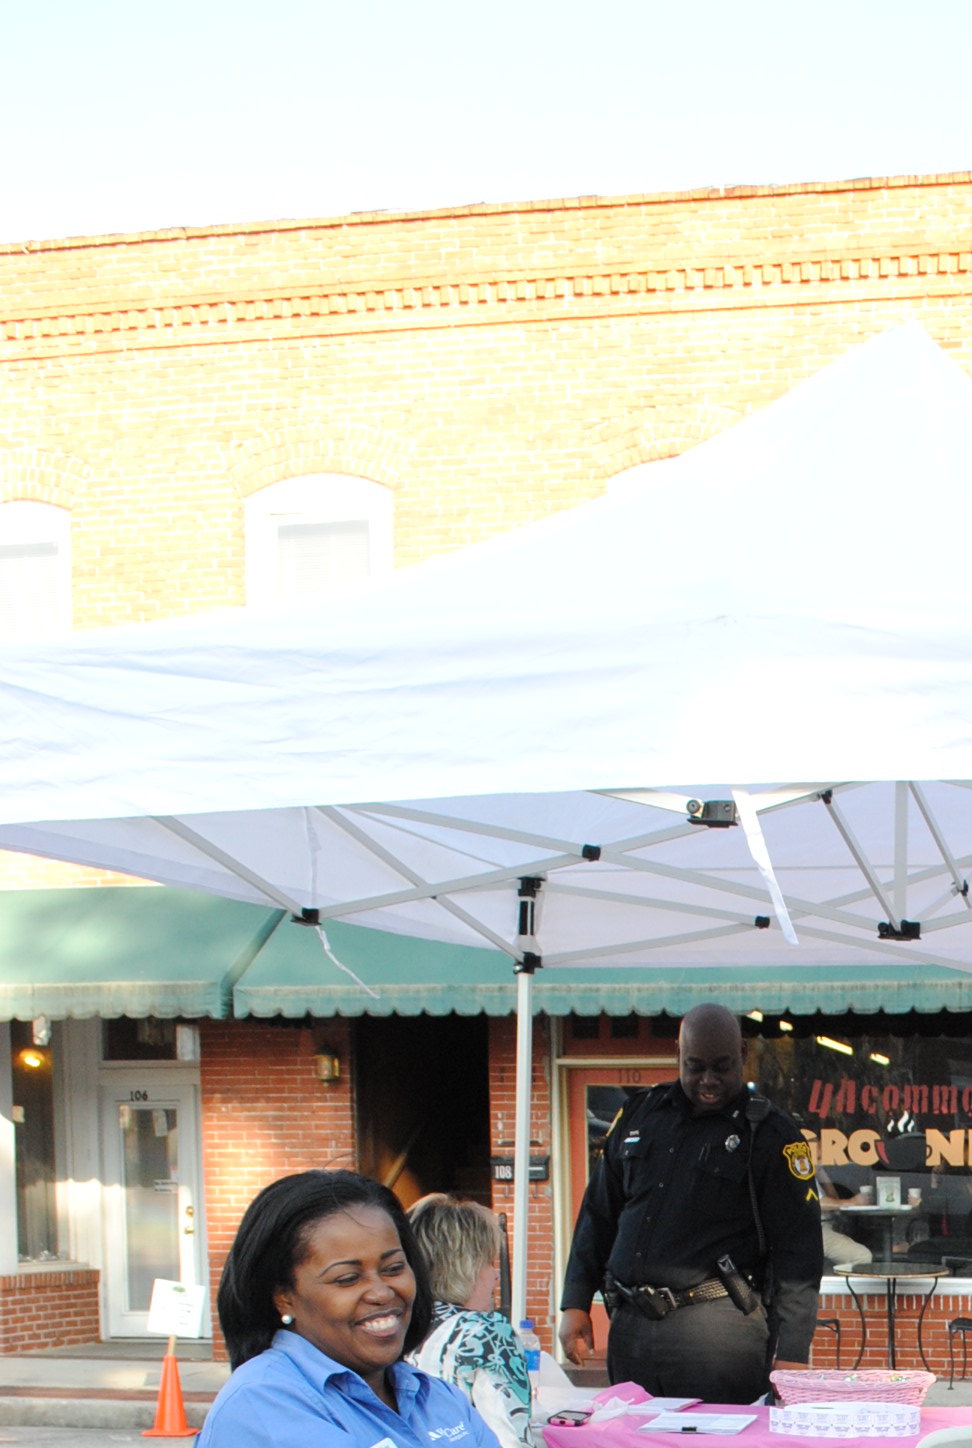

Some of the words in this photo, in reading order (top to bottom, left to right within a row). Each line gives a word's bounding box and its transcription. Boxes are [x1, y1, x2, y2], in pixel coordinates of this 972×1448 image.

[617, 1070, 641, 1083] 110
[129, 1090, 148, 1101] 106
[495, 1165, 512, 1179] 108
